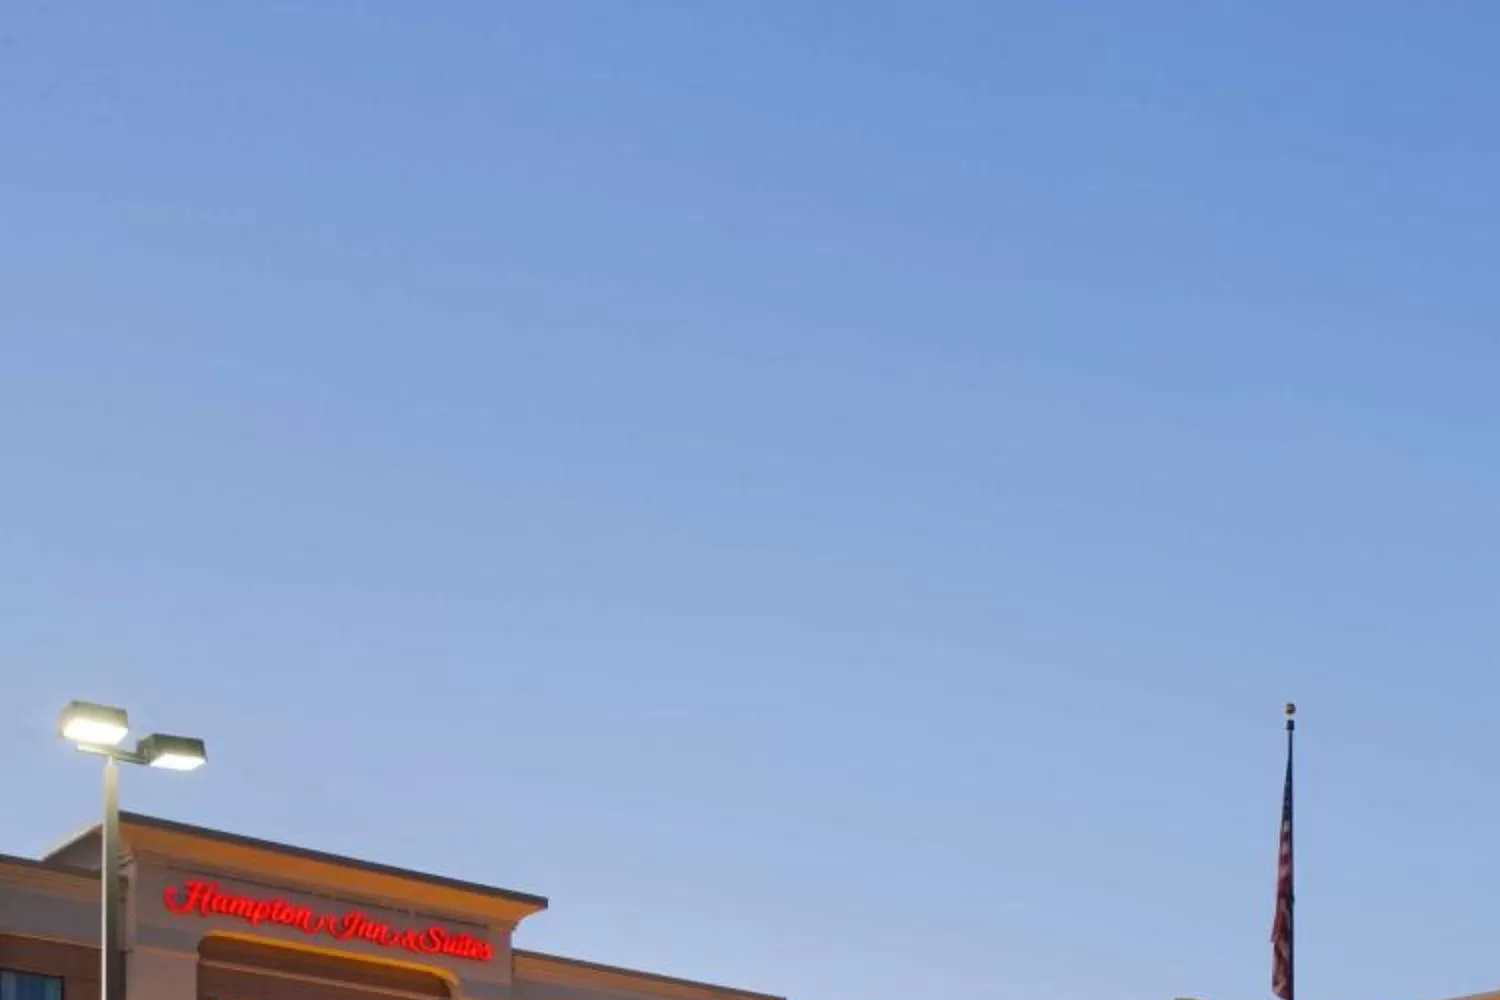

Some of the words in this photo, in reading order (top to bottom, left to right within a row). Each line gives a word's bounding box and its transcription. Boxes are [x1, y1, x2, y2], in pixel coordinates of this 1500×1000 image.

[164, 880, 325, 935] Hampton
[326, 909, 400, 946] Inn
[400, 927, 421, 952] &
[419, 926, 495, 962] Suites
